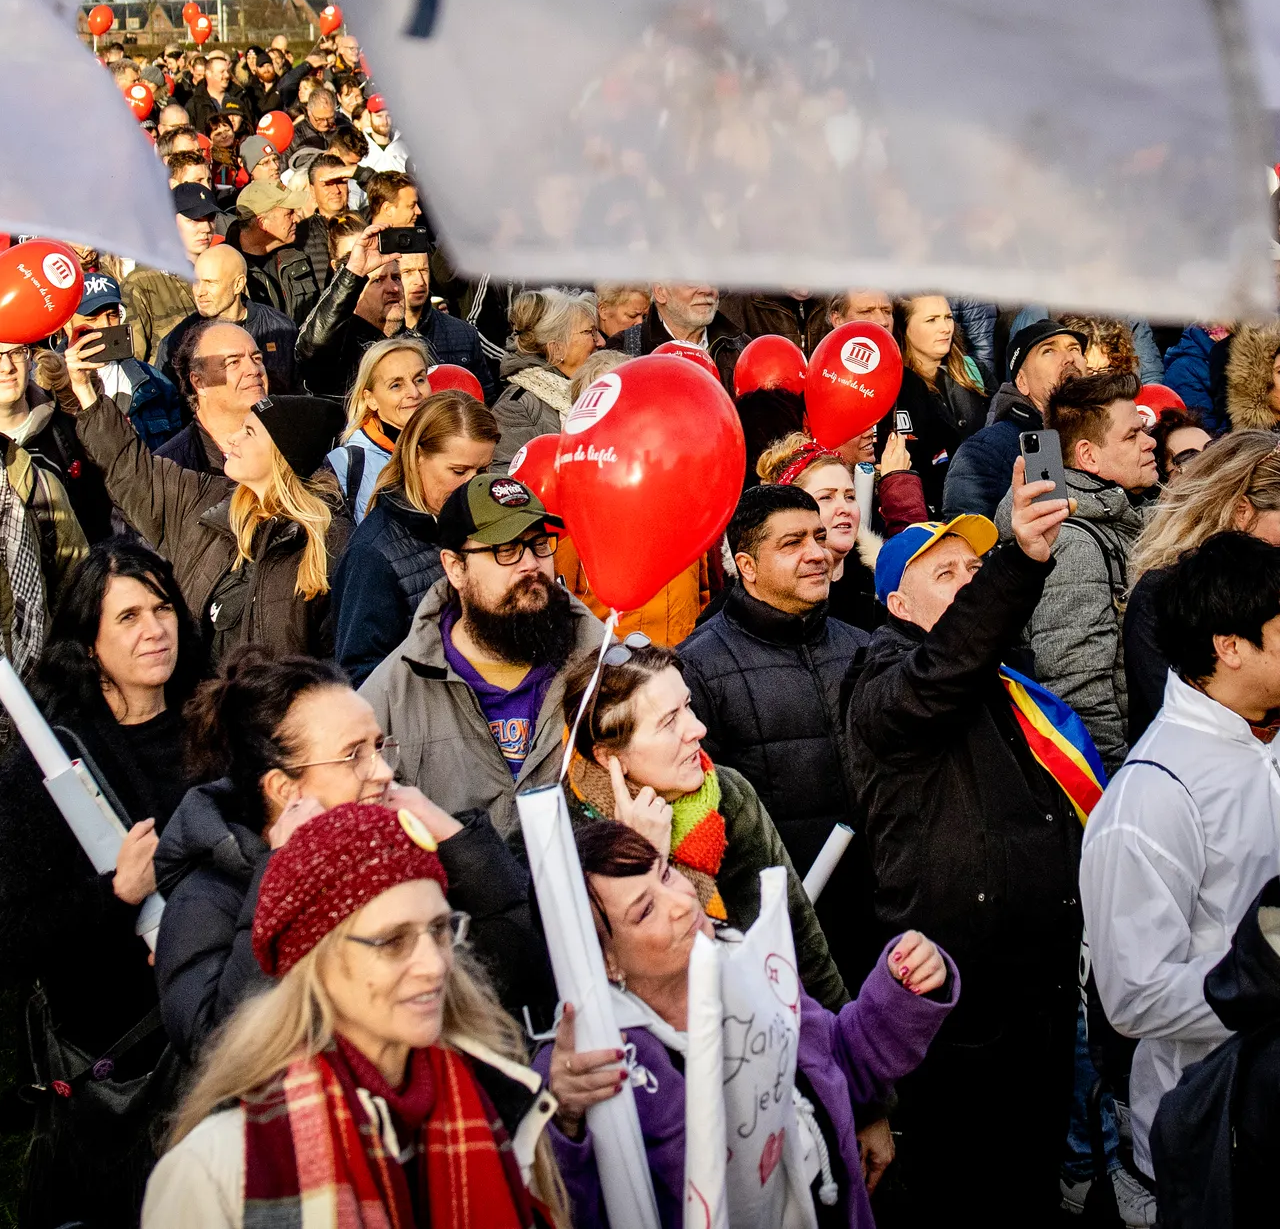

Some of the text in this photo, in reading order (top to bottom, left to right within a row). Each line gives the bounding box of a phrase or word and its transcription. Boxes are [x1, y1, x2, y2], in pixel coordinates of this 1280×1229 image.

[83, 276, 116, 296] DIOR
[822, 368, 875, 398] Partij van de liefde
[573, 444, 586, 461] de
[586, 444, 619, 469] liefde
